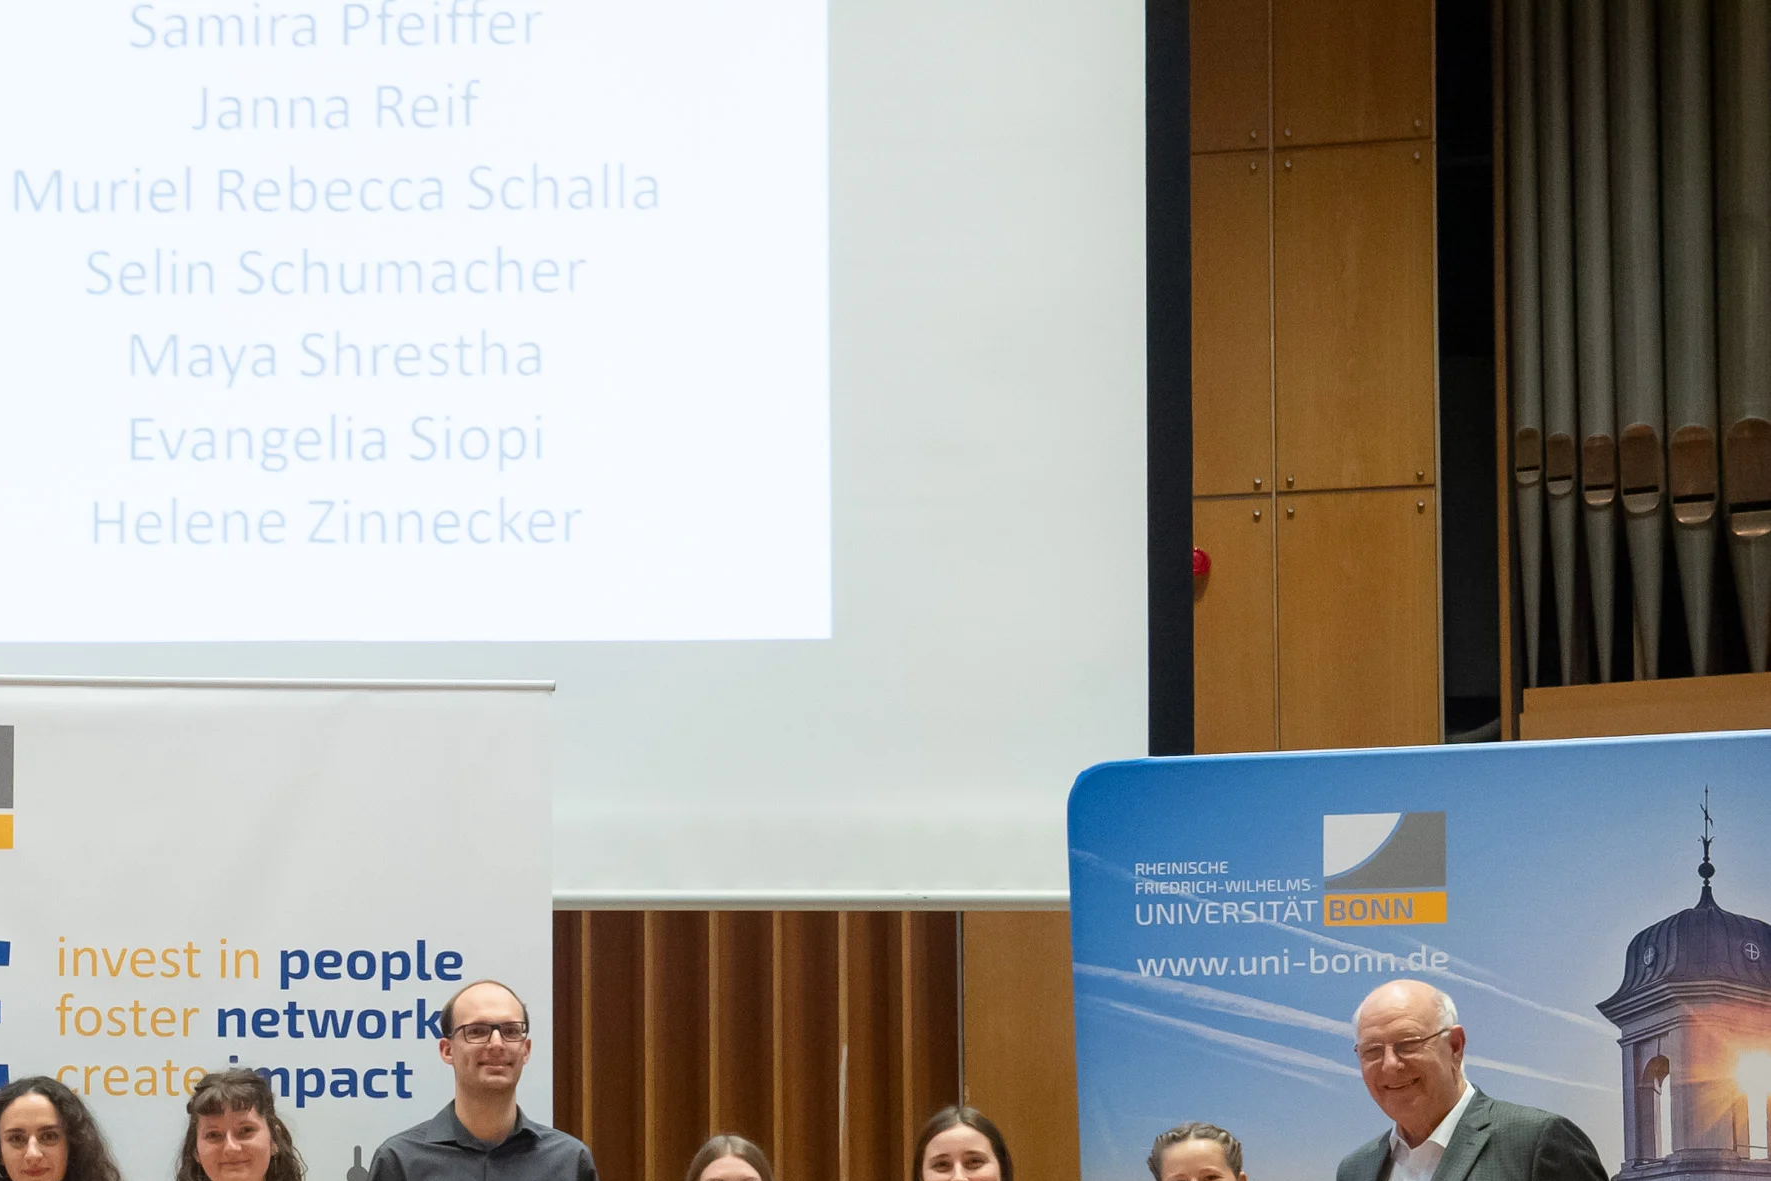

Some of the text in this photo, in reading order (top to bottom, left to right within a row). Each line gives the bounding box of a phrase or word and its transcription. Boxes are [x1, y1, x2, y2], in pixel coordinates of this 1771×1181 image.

[129, 0, 544, 49] Samira Pfeiffer
[191, 79, 481, 131] Janna Reif
[13, 162, 660, 214] Muriel Rebecca Schalla
[85, 245, 587, 297] Selin Schumacher
[130, 328, 543, 389] Maya Shrestha
[129, 413, 544, 473] Evangelia Siopi
[92, 496, 584, 546] Helene Zinnecker
[1134, 860, 1229, 876] RHEINISCHE
[1134, 877, 1318, 895] FRIEDRICH-WILHELMS-
[1135, 896, 1414, 926] UNIVERSITÄT BONN
[57, 936, 464, 991] invest in people
[1136, 945, 1450, 978] www.uni-bonn.de
[56, 992, 200, 1038] foster
[56, 1055, 413, 1109] create mpact
